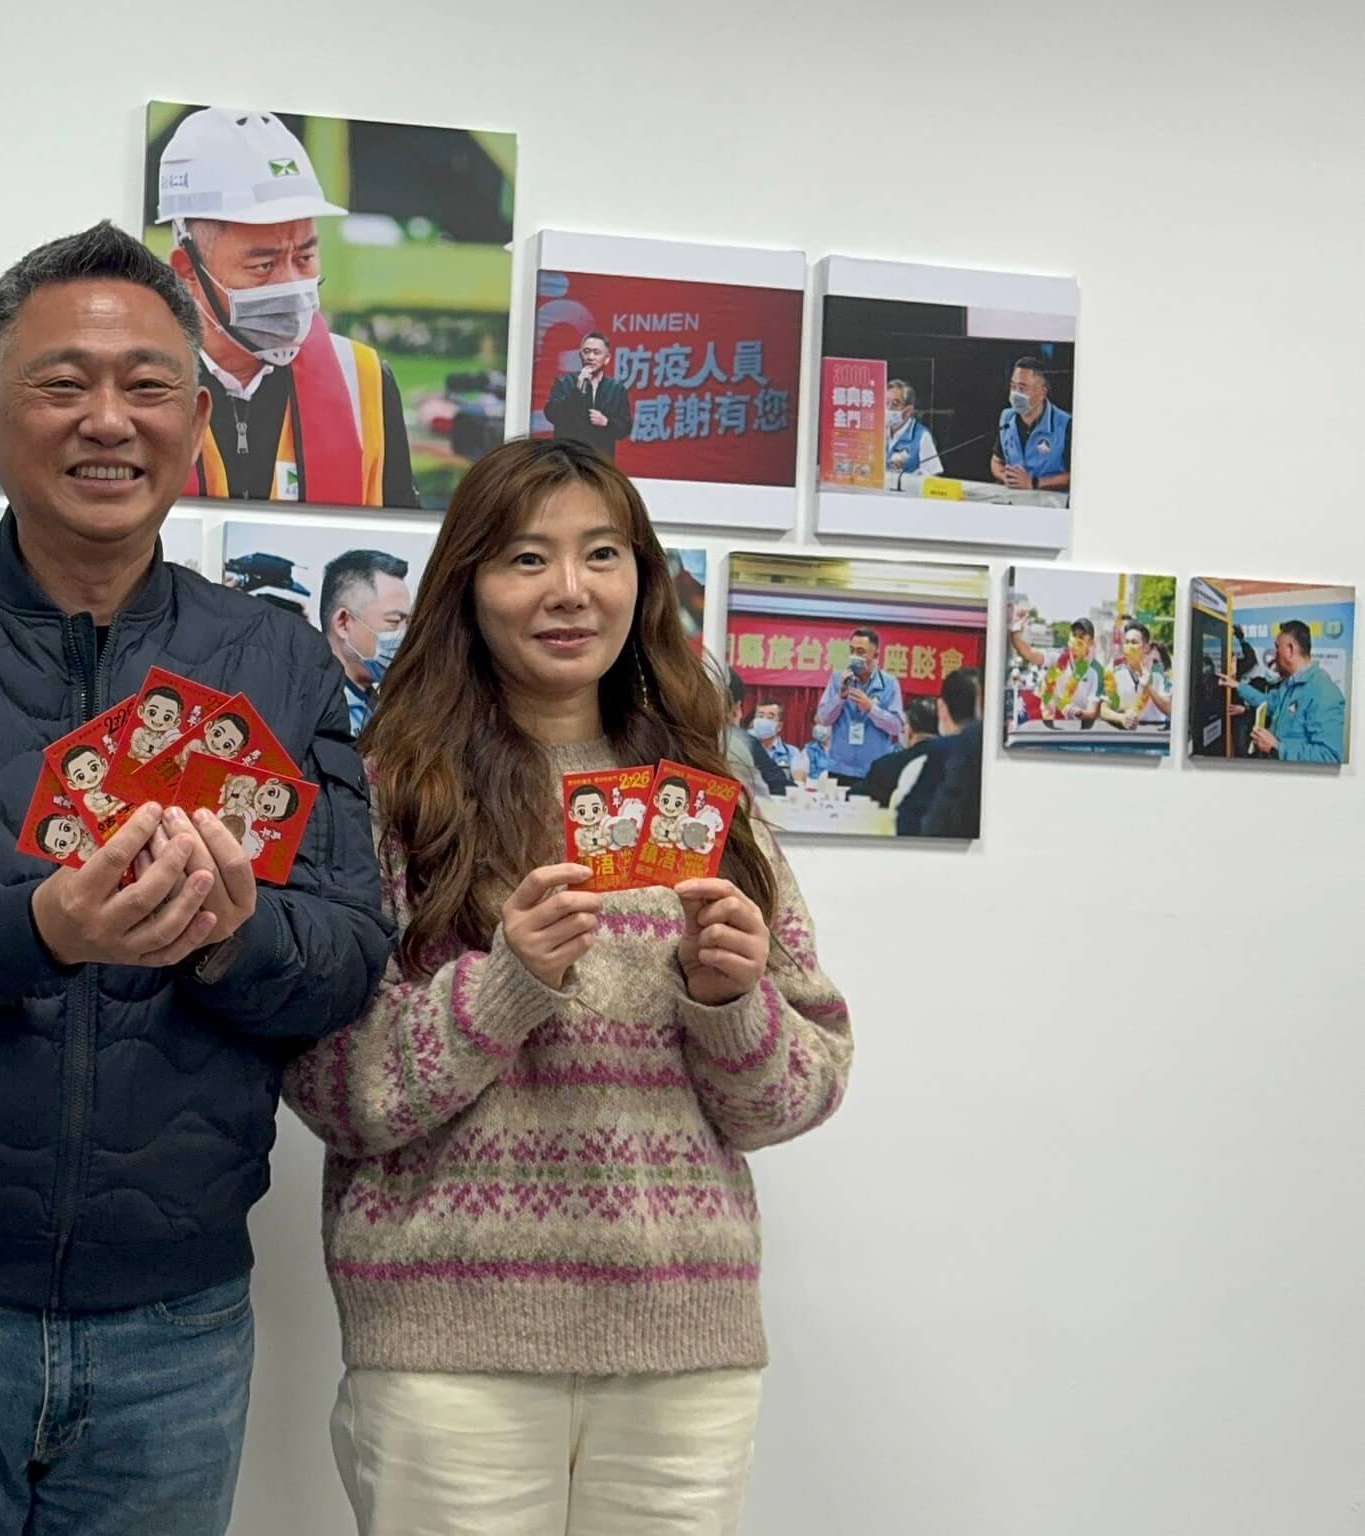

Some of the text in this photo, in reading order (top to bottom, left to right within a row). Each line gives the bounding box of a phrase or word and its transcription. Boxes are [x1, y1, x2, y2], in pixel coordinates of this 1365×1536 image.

[612, 313, 700, 332] KINMEN
[614, 340, 769, 389] 防疫人員
[630, 388, 788, 442] 感謝有您
[619, 770, 651, 790] 2026
[706, 779, 736, 801] 2026
